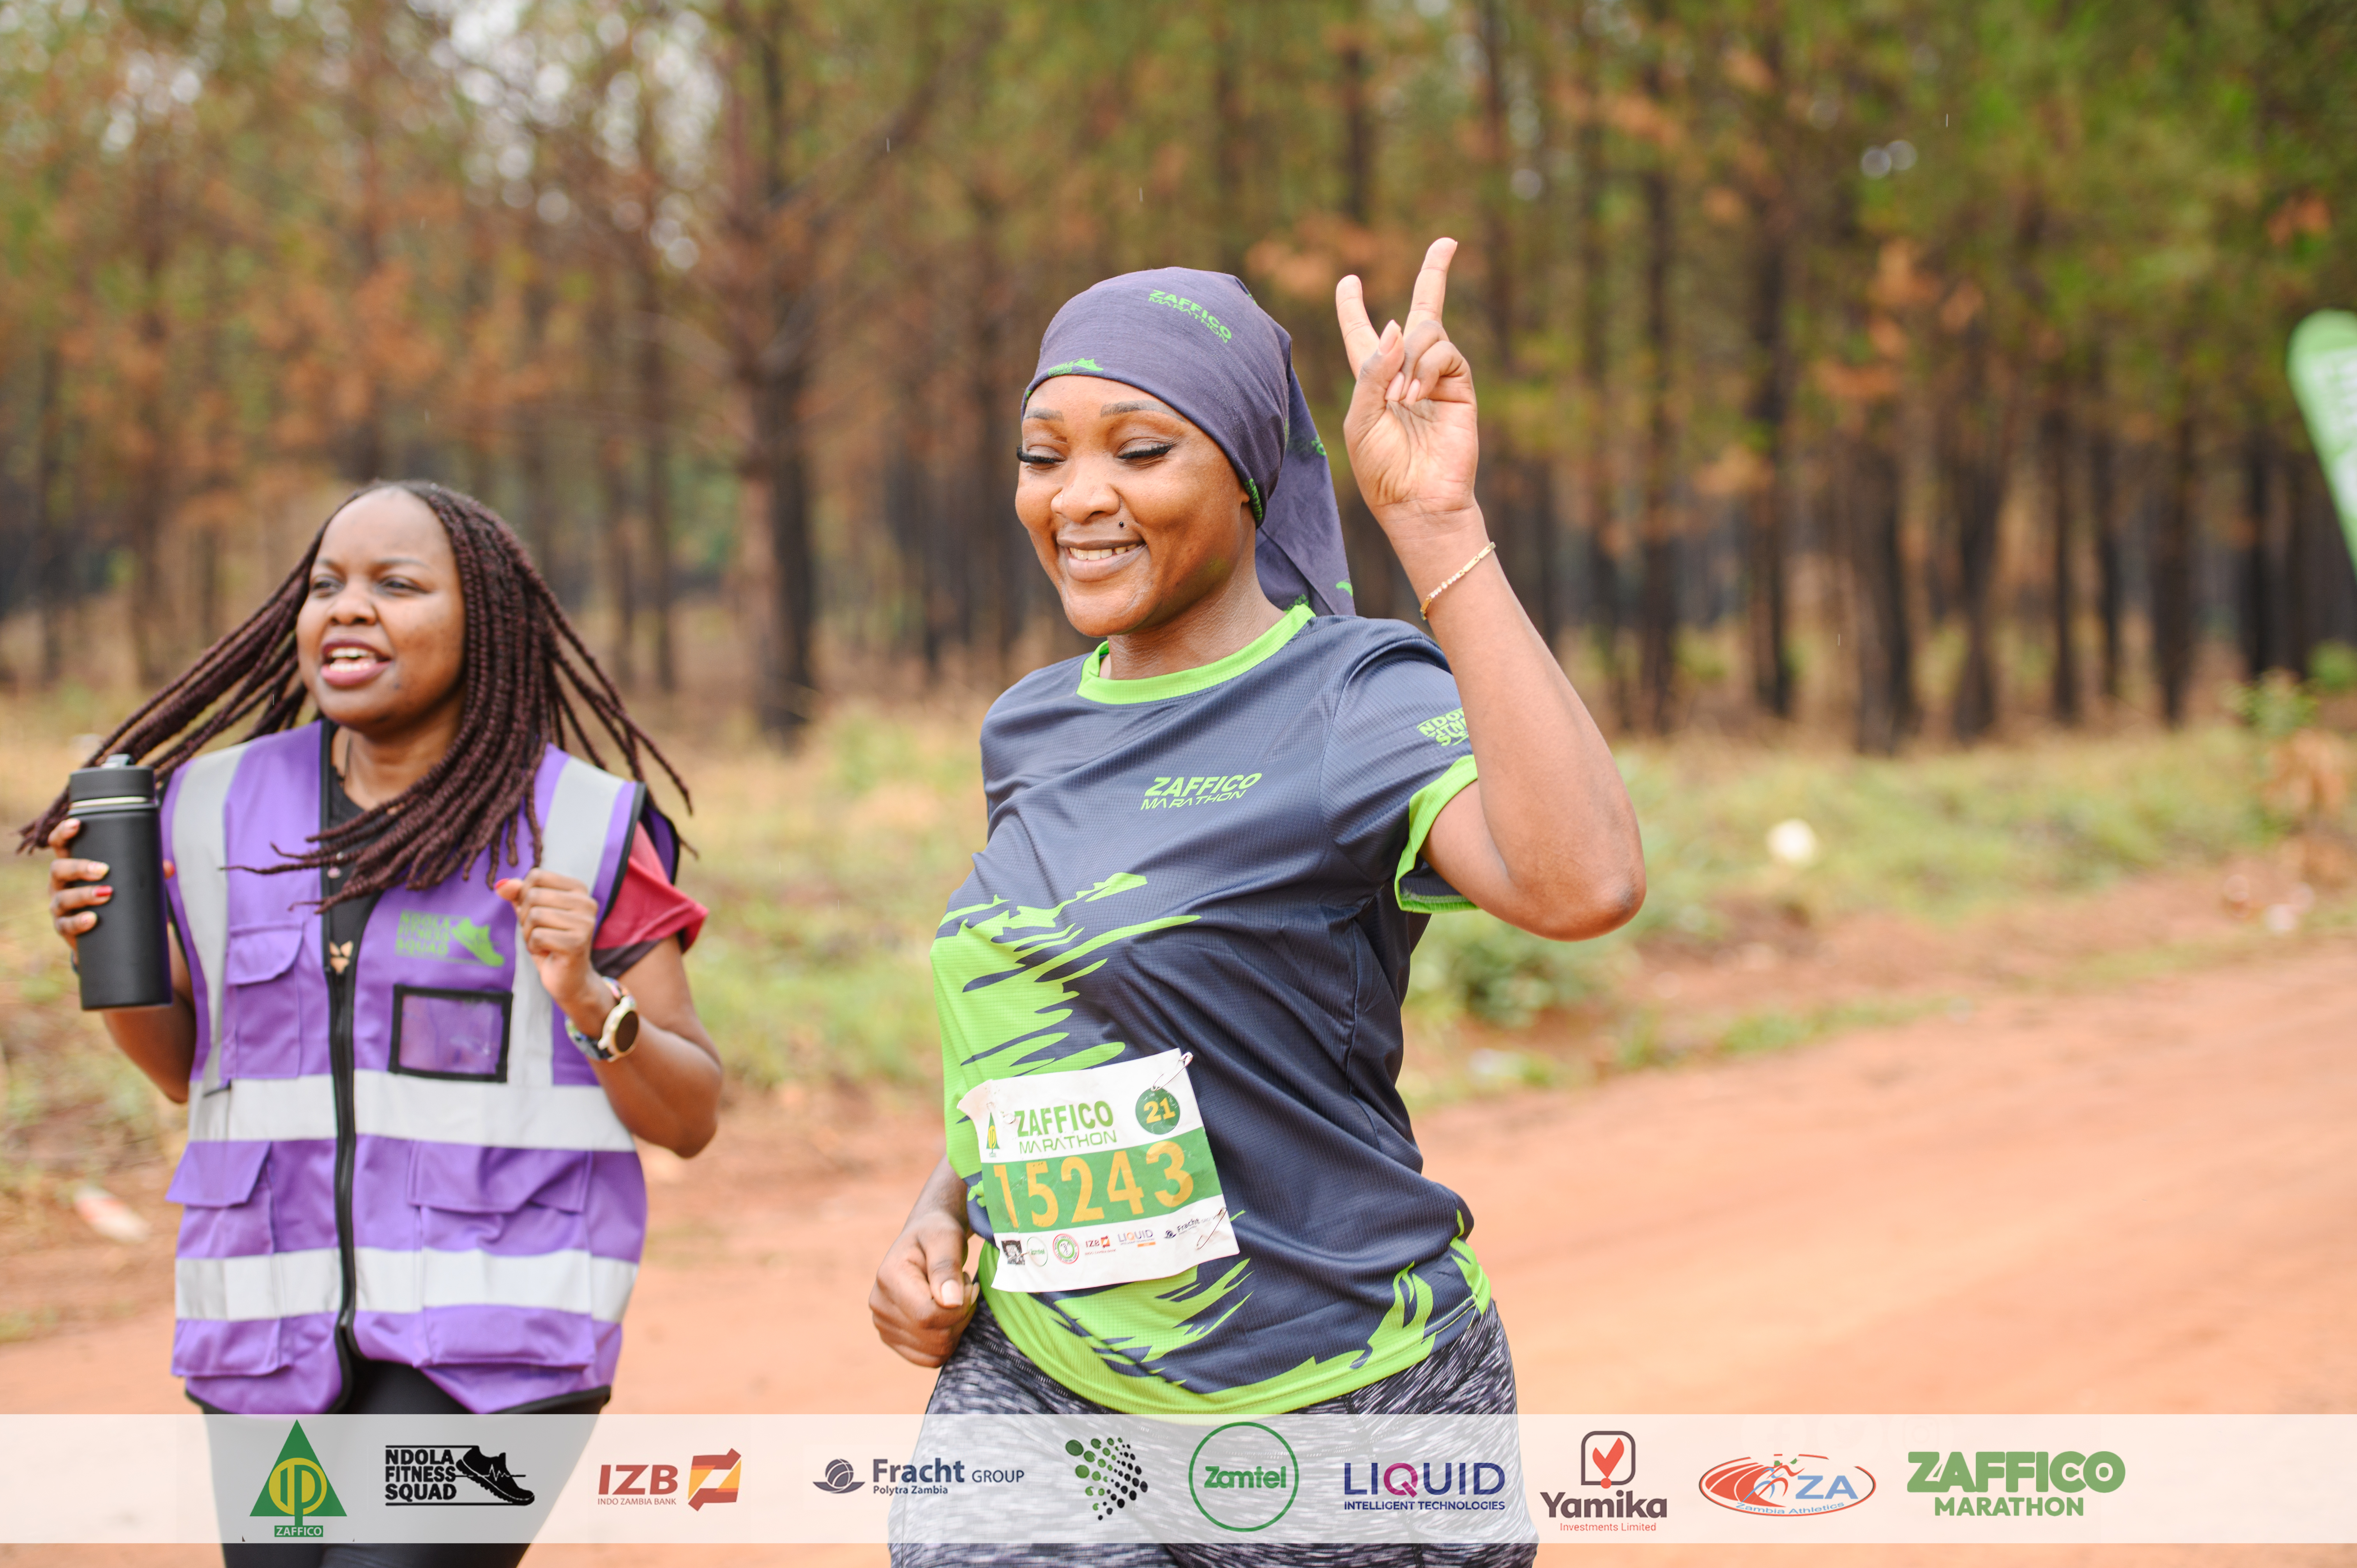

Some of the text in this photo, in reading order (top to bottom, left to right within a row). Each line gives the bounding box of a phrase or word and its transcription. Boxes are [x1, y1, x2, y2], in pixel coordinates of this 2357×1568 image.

[1148, 297, 1228, 343] MARATHON
[1149, 289, 1232, 339] ZAFFICO
[1144, 773, 1262, 797] ZAFFICO
[1140, 789, 1247, 810] MARATHON
[400, 913, 450, 929] NDOLA
[396, 938, 449, 955] SQUAD
[1014, 1100, 1114, 1137] ZAFFICO
[1143, 1097, 1176, 1124] 21
[1019, 1130, 1117, 1154] MARATHON
[993, 1141, 1194, 1228] 15243
[1117, 1229, 1153, 1243] LIQUID
[1177, 1217, 1200, 1233] Fracht
[1085, 1240, 1100, 1248] IZB
